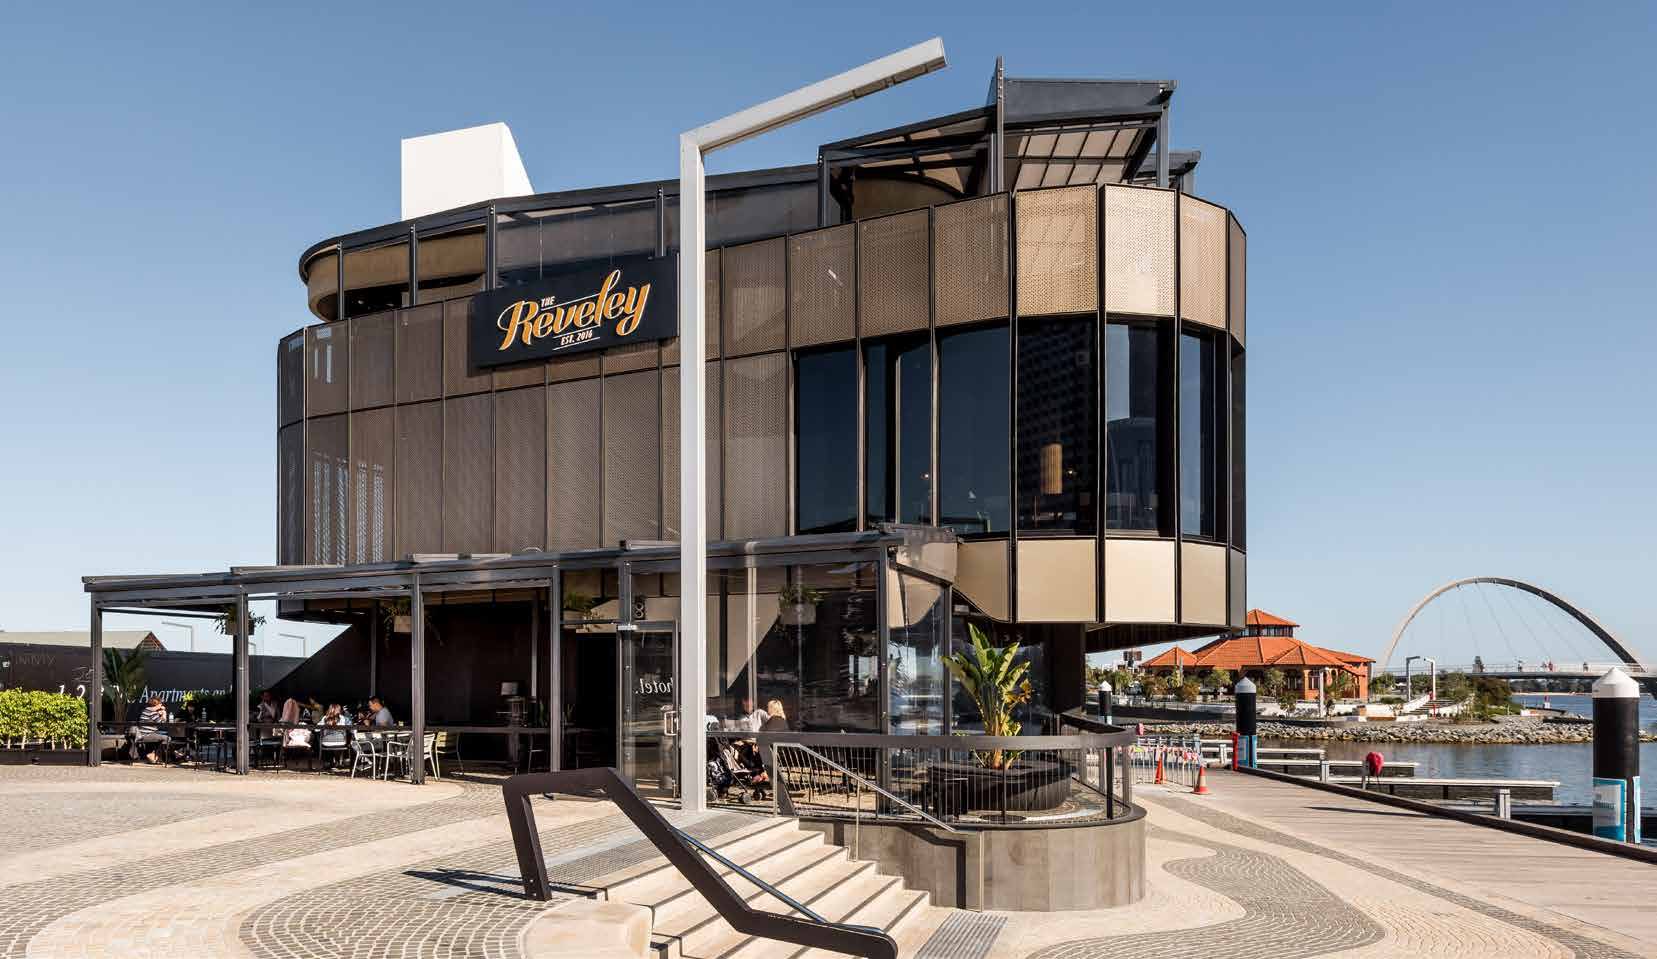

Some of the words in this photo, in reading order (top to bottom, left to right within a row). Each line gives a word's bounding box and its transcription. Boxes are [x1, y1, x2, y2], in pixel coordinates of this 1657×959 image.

[497, 269, 651, 350] Reveley
[541, 296, 555, 308] THE
[561, 335, 575, 346] EST.
[576, 330, 593, 341] 2016
[140, 685, 210, 703] Apartmts
